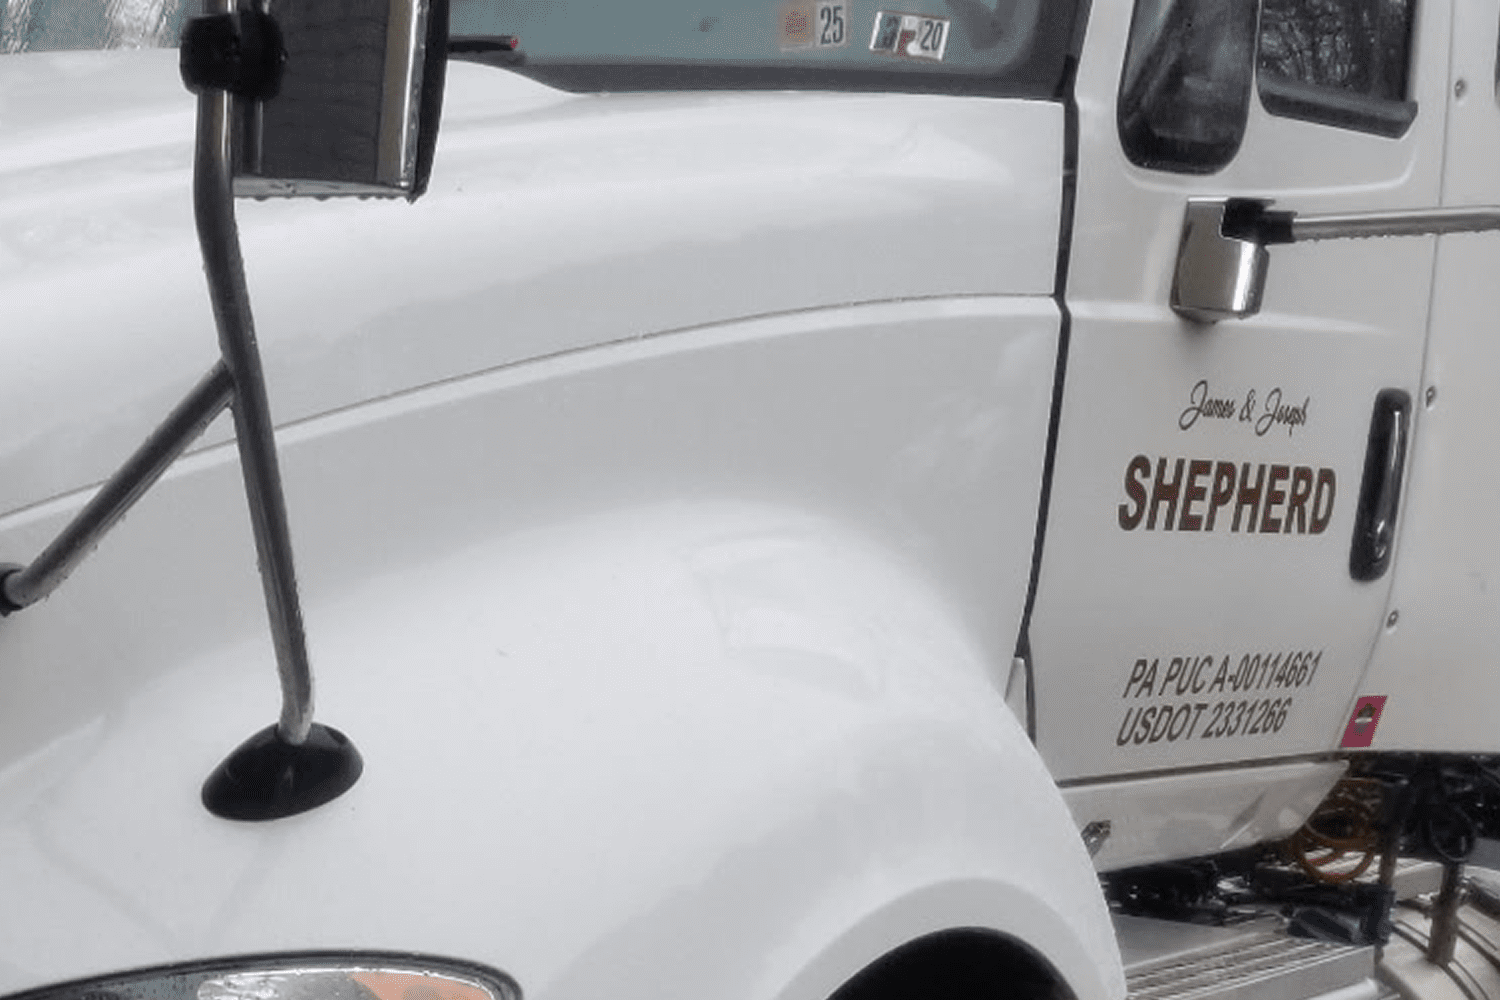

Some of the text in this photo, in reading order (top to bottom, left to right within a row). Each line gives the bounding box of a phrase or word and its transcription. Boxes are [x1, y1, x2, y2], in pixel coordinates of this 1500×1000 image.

[820, 6, 844, 45] 25
[920, 20, 944, 52] 20
[1178, 380, 1310, 437] James & Joseph
[1117, 455, 1337, 535] SHEPHERD
[1122, 651, 1323, 699] PA PUC A-00114661
[1116, 697, 1293, 747] USDOT 2331266
